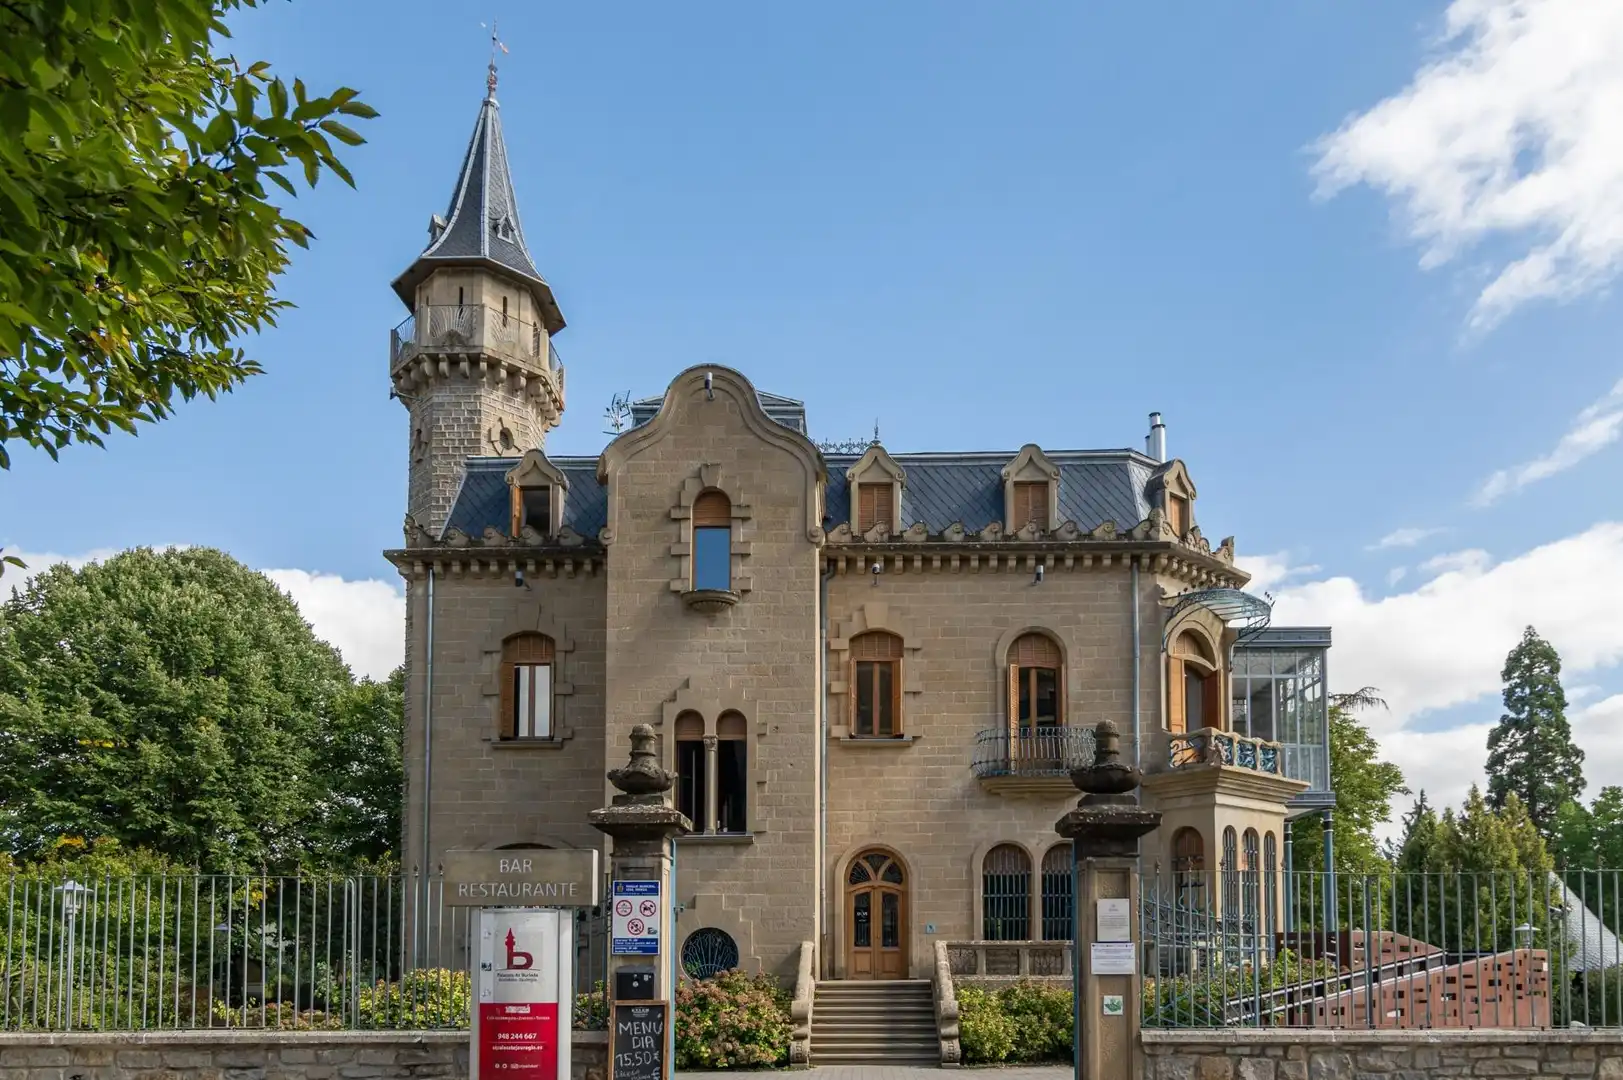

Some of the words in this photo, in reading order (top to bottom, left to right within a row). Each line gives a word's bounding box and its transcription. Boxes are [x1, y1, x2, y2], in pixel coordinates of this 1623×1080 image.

[499, 859, 532, 873] BAR
[458, 883, 578, 897] RESTAURANTE
[619, 1014, 662, 1036] MENÚ
[632, 1036, 654, 1049] DIA
